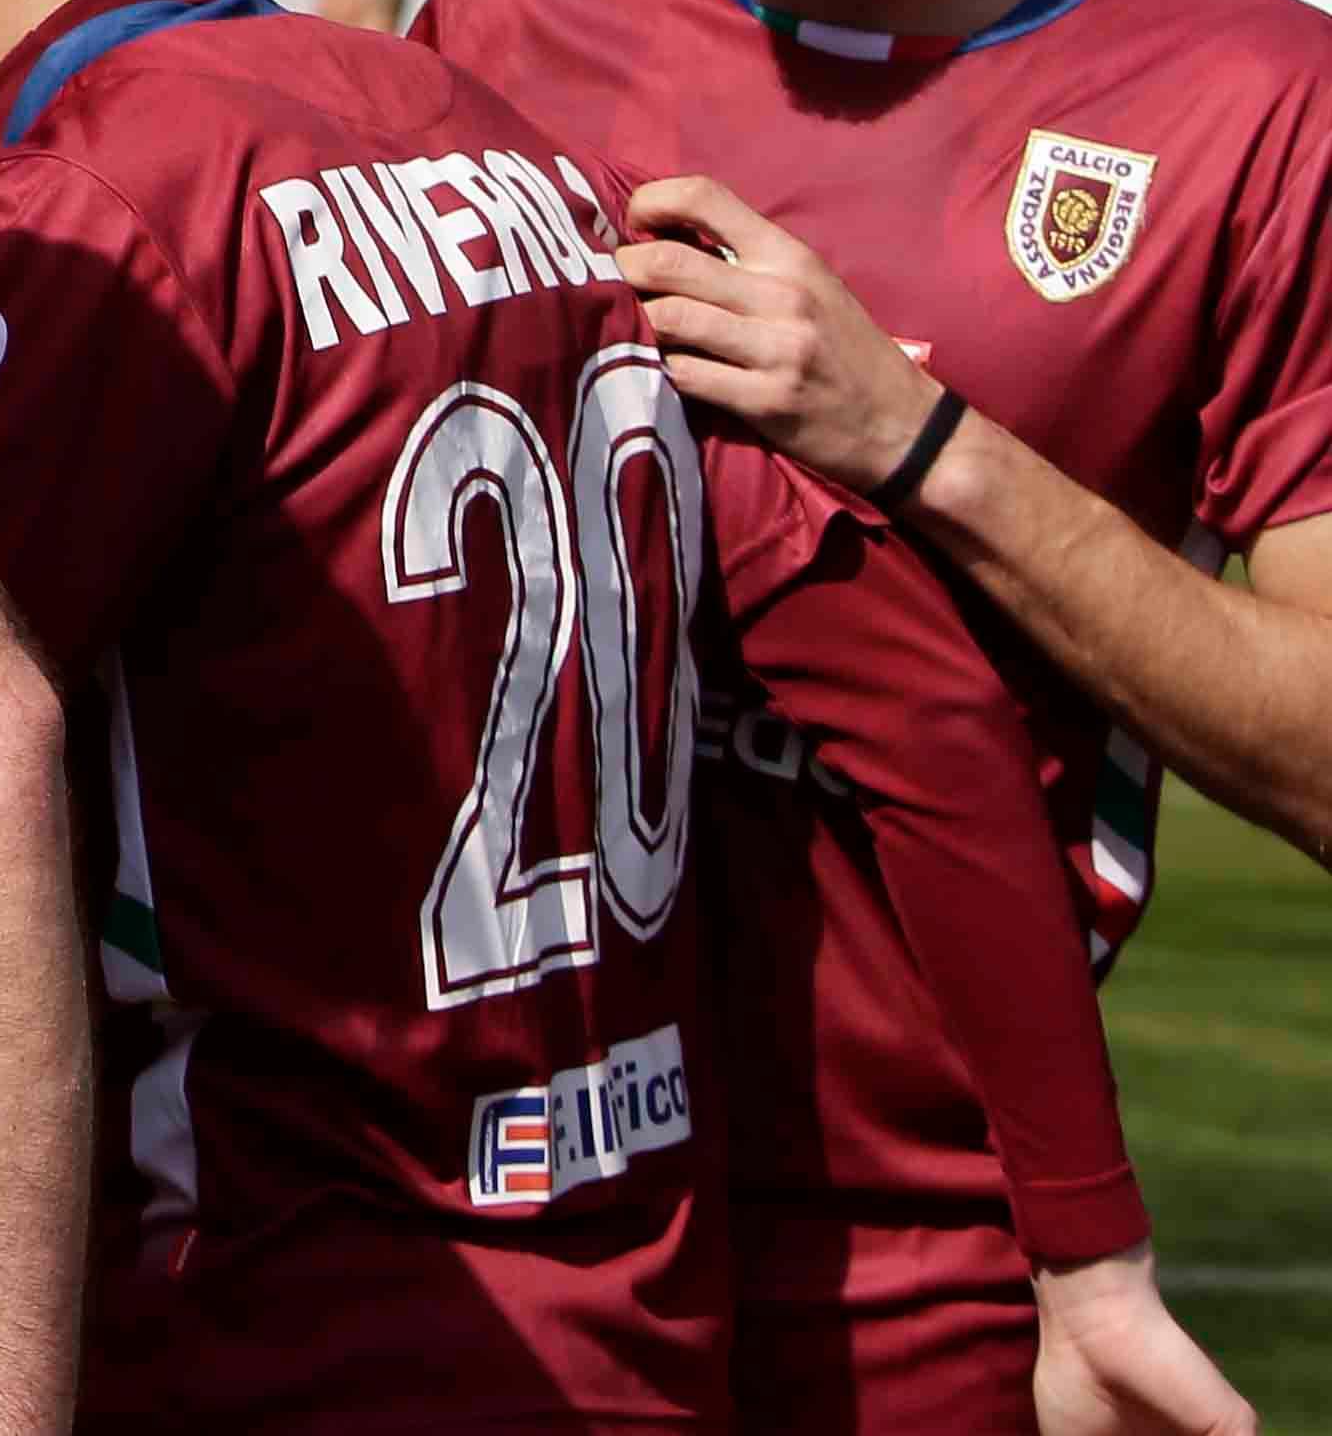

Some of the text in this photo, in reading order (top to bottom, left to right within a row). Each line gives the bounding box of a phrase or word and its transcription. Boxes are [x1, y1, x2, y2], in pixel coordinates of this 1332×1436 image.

[1049, 145, 1132, 177] CALCIO
[1061, 189, 1138, 289] REGGIANA
[382, 342, 703, 1011] 20
